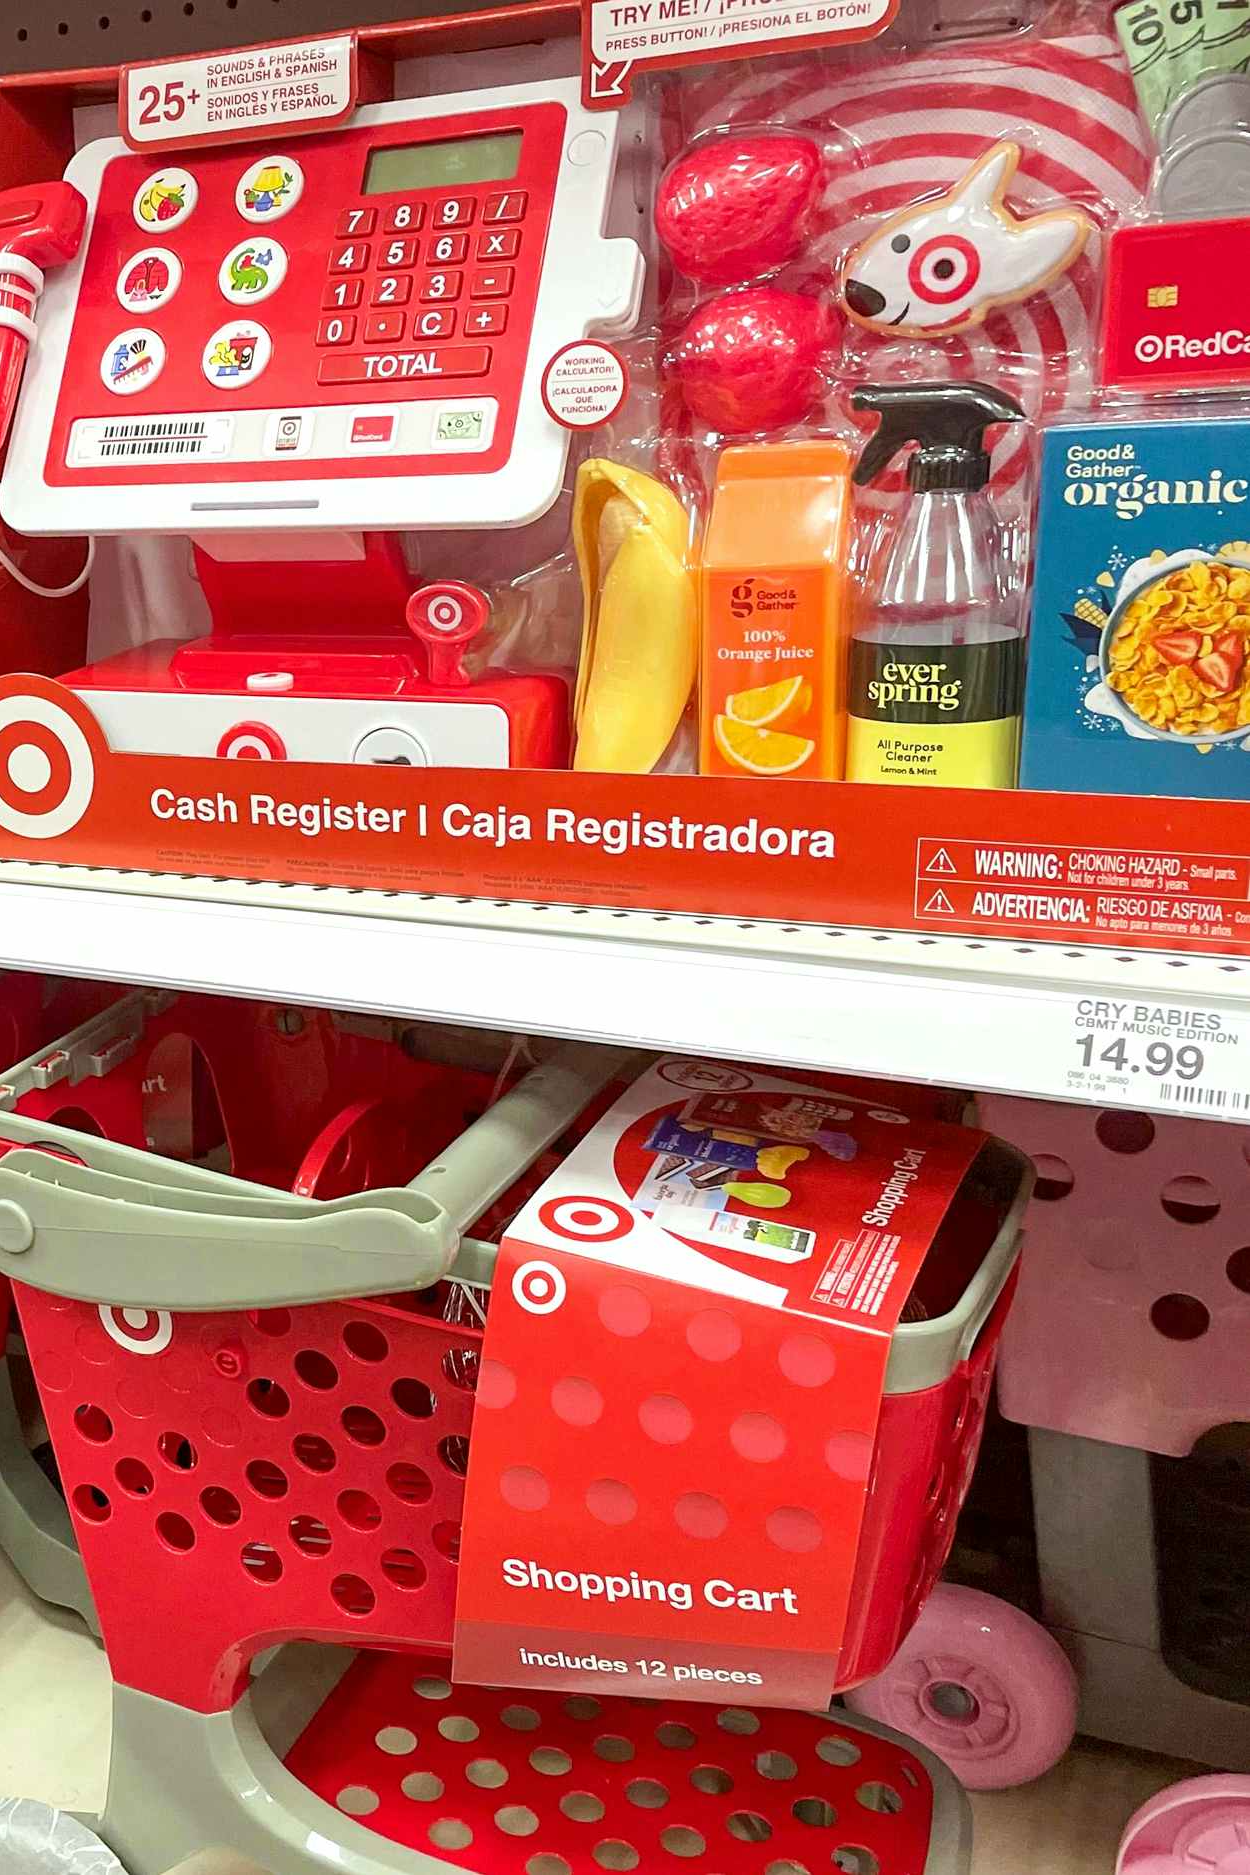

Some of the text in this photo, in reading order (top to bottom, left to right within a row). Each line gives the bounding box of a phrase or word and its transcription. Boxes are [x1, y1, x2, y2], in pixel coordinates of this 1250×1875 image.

[610, 4, 651, 27] TRY
[659, 0, 698, 20] ME!
[1127, 4, 1164, 46] 10
[606, 36, 647, 51] PRESS
[651, 27, 708, 45] BUTTON!
[719, 15, 791, 38] ¡PRESIONA
[796, 12, 812, 23] EL
[207, 47, 325, 76] SOUNDS & PHRASES
[207, 59, 337, 89] IN ENGLISH & SPANISH
[139, 80, 200, 125] 25+
[207, 83, 319, 109] SONIDOS Y FRASES
[207, 111, 222, 122] EN
[270, 102, 278, 113] Y
[281, 94, 338, 112] ESPAÑOL
[363, 353, 442, 377] TOTAL
[555, 366, 615, 377] CALCULATOR!
[565, 357, 606, 366] WORKING
[561, 405, 607, 414] FUNCIONA!
[575, 395, 593, 404] QUE
[1066, 462, 1135, 479] Gather
[1064, 470, 1247, 519] organic
[756, 601, 797, 611] Gather
[743, 629, 786, 643] 100%
[718, 645, 814, 662] Orange Juice
[883, 660, 947, 684] ever
[868, 679, 961, 711] spring
[877, 740, 944, 755] All Purpose
[885, 752, 932, 763] Cleaner
[881, 766, 937, 776] Lemon & Mint
[150, 788, 837, 859] Cash Register Caja Registradora
[975, 850, 1180, 880] WARNING: CHOKING HAZARD
[971, 892, 1090, 924] ADVERTENCIA:
[1097, 896, 1147, 916] RIESGO
[1150, 900, 1169, 918] DE
[1171, 902, 1223, 922] ASFIXIA
[1077, 1000, 1222, 1030] CRY BABIES
[1075, 1016, 1239, 1045] CBMT MUSIC EDITION
[1076, 1033, 1204, 1080] 14.99
[862, 1167, 918, 1227] Shopping
[502, 1558, 799, 1615] Shopping Cart
[519, 1647, 763, 1687] includes 12 pieces
